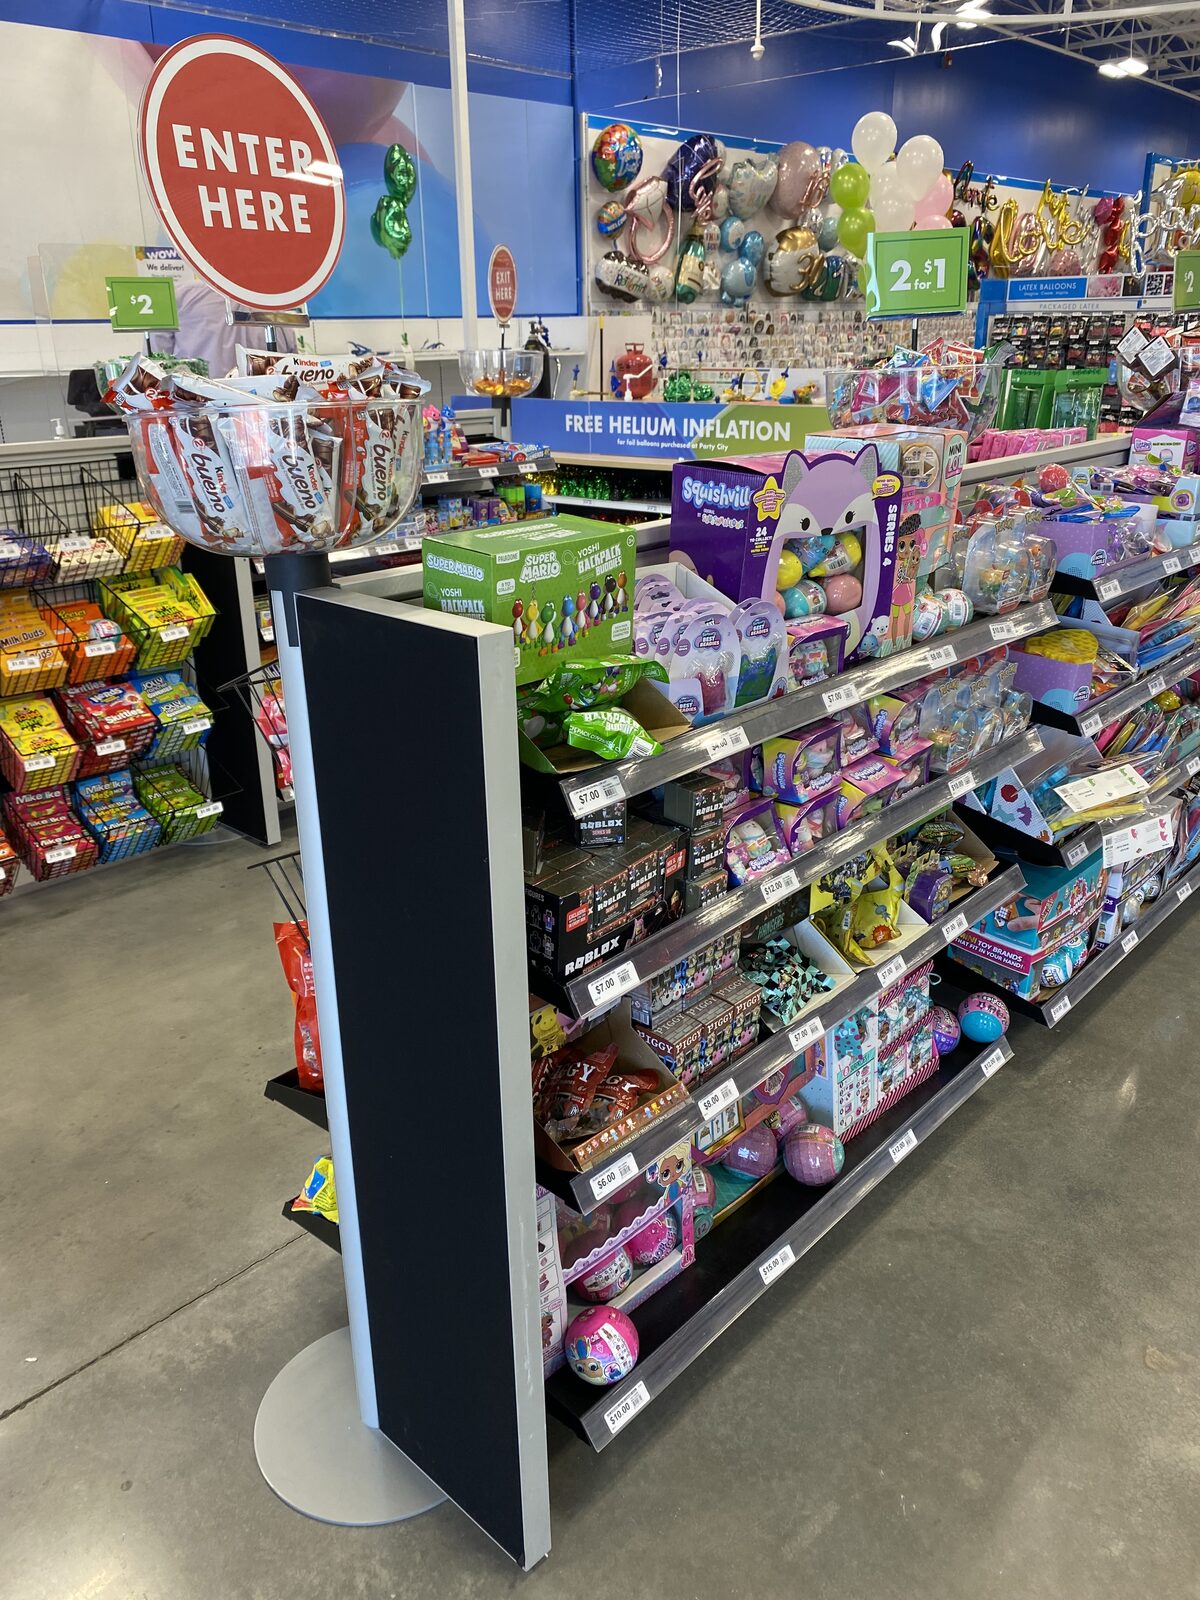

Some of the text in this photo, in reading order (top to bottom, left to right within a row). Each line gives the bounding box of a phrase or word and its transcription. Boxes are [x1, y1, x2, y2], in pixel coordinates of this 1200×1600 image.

[171, 123, 314, 178] ENTER
[197, 184, 312, 234] HERE
[147, 263, 184, 271] We deliver!
[889, 258, 946, 292] 2 for $1
[495, 271, 511, 285] EXIT
[1018, 282, 1077, 292] LATEX BALLOONS
[1184, 270, 1195, 293] $2
[495, 287, 512, 300] HERE
[130, 294, 154, 315] $2
[1039, 302, 1100, 310] PACKAGED LATEX
[565, 414, 791, 442] FREE HELIUM INFLATION
[616, 438, 626, 446] for
[626, 438, 636, 446] foil
[636, 438, 660, 448] balloons
[660, 440, 691, 449] purchased
[699, 442, 716, 451] Party
[716, 443, 729, 451] City
[282, 455, 317, 509] bueno
[373, 443, 391, 501] bueno
[191, 453, 225, 513] bueno
[682, 476, 755, 510] Squishvill
[755, 526, 767, 537] 24
[883, 504, 898, 553] SERIES
[525, 550, 557, 566] SUPER
[578, 542, 600, 559] YOSHI
[578, 544, 621, 574] BACKPACK
[427, 553, 485, 582] SUPER MARIO
[520, 561, 561, 583] MARIO
[882, 557, 892, 567] 4
[440, 588, 463, 597] YOSHI
[440, 599, 485, 613] BACKPACK
[1, 628, 46, 648] Milk Duds
[827, 692, 843, 704] $7.00
[104, 706, 145, 725] Skittles
[15, 794, 43, 805] Mike
[578, 788, 600, 805] $7.00
[695, 802, 724, 817] ROBLOX
[580, 819, 623, 830] ROBLOX
[694, 847, 724, 866] ROBLOX
[630, 869, 657, 891] ROBLOX
[764, 880, 783, 896] $12.00
[597, 889, 627, 912] ROBLOX
[564, 936, 620, 977] ROBLOX
[969, 942, 979, 951] FIT
[986, 950, 1003, 962] YOUR
[1002, 957, 1024, 970] HAND!
[977, 940, 993, 950] TOY
[992, 946, 1023, 962] BRANDS
[880, 969, 894, 981] $7.00
[595, 977, 615, 995] $7.00
[716, 977, 746, 996] PIGGY
[687, 996, 717, 1016] PIGGY
[736, 993, 761, 1014] PIGGY
[654, 1012, 685, 1035] PIGGY
[707, 1011, 734, 1034] PIGGY
[636, 1029, 674, 1054] PIGGY
[676, 1028, 703, 1054] PIGGY
[793, 1027, 808, 1043] $7.00
[703, 1094, 720, 1111] $8.00
[891, 1139, 906, 1157] $12.00
[596, 1172, 616, 1190] $6.00
[762, 1257, 780, 1277] $15.00
[609, 1401, 631, 1425] $10.00
